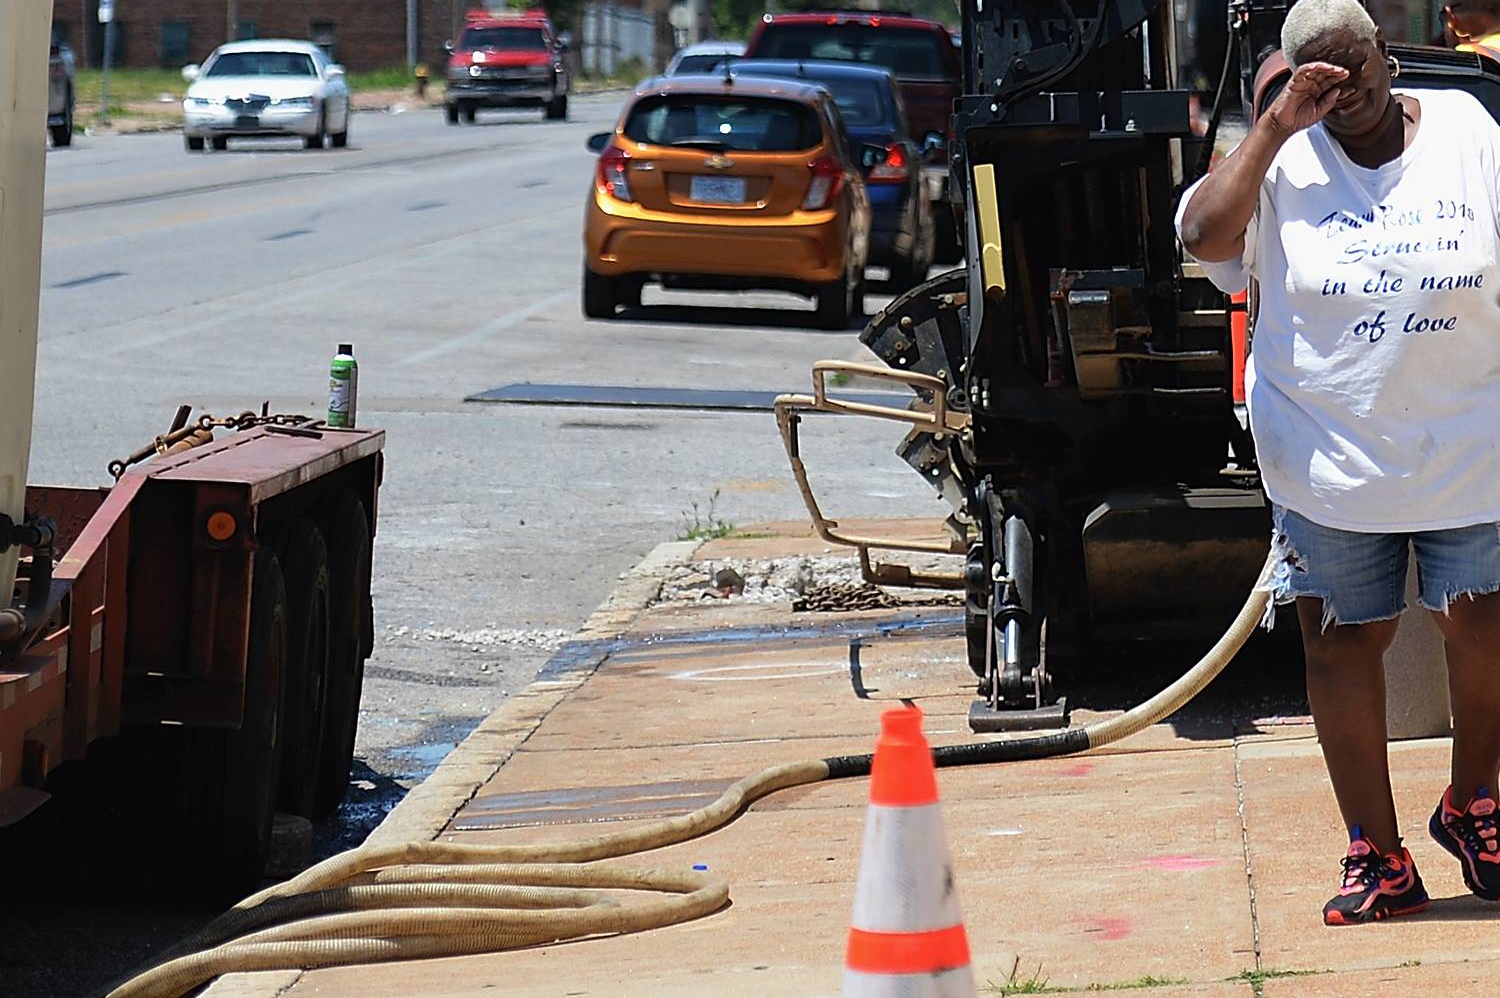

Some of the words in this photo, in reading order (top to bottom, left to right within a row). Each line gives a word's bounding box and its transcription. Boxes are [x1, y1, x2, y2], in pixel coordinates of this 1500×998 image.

[1322, 278, 1347, 297] in
[1362, 269, 1404, 294] the
[1419, 272, 1484, 292] name
[1353, 310, 1387, 343] of
[1402, 312, 1458, 334] love
